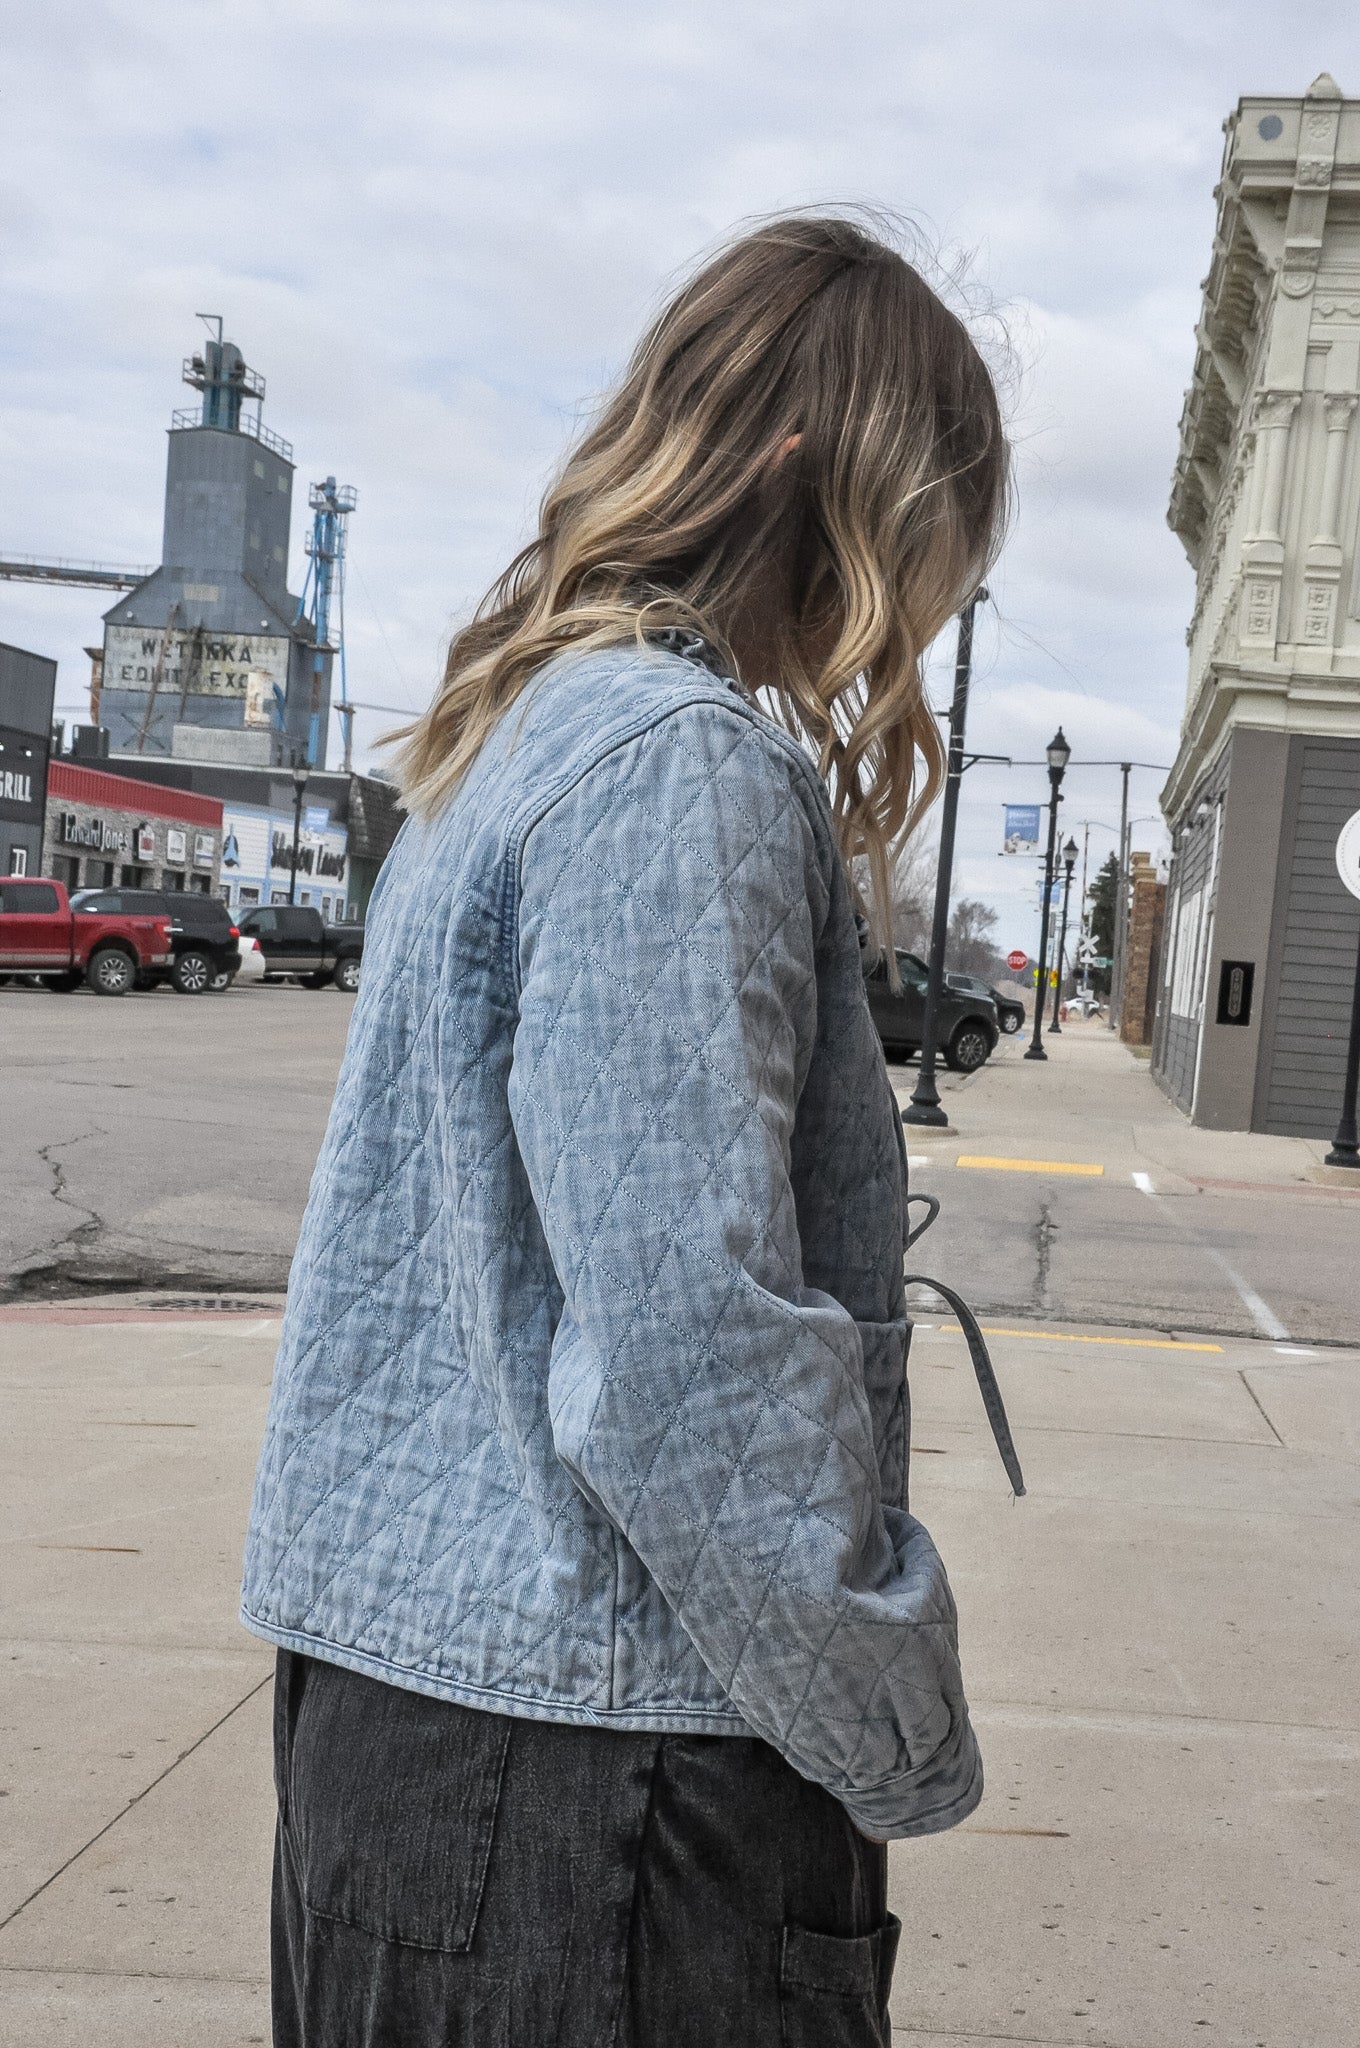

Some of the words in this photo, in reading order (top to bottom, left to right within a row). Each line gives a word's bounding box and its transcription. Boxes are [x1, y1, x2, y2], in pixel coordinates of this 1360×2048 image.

[121, 664, 199, 685] EQIT
[65, 812, 101, 847] Edward
[101, 820, 129, 852] Jones
[1008, 956, 1026, 965] STOP
